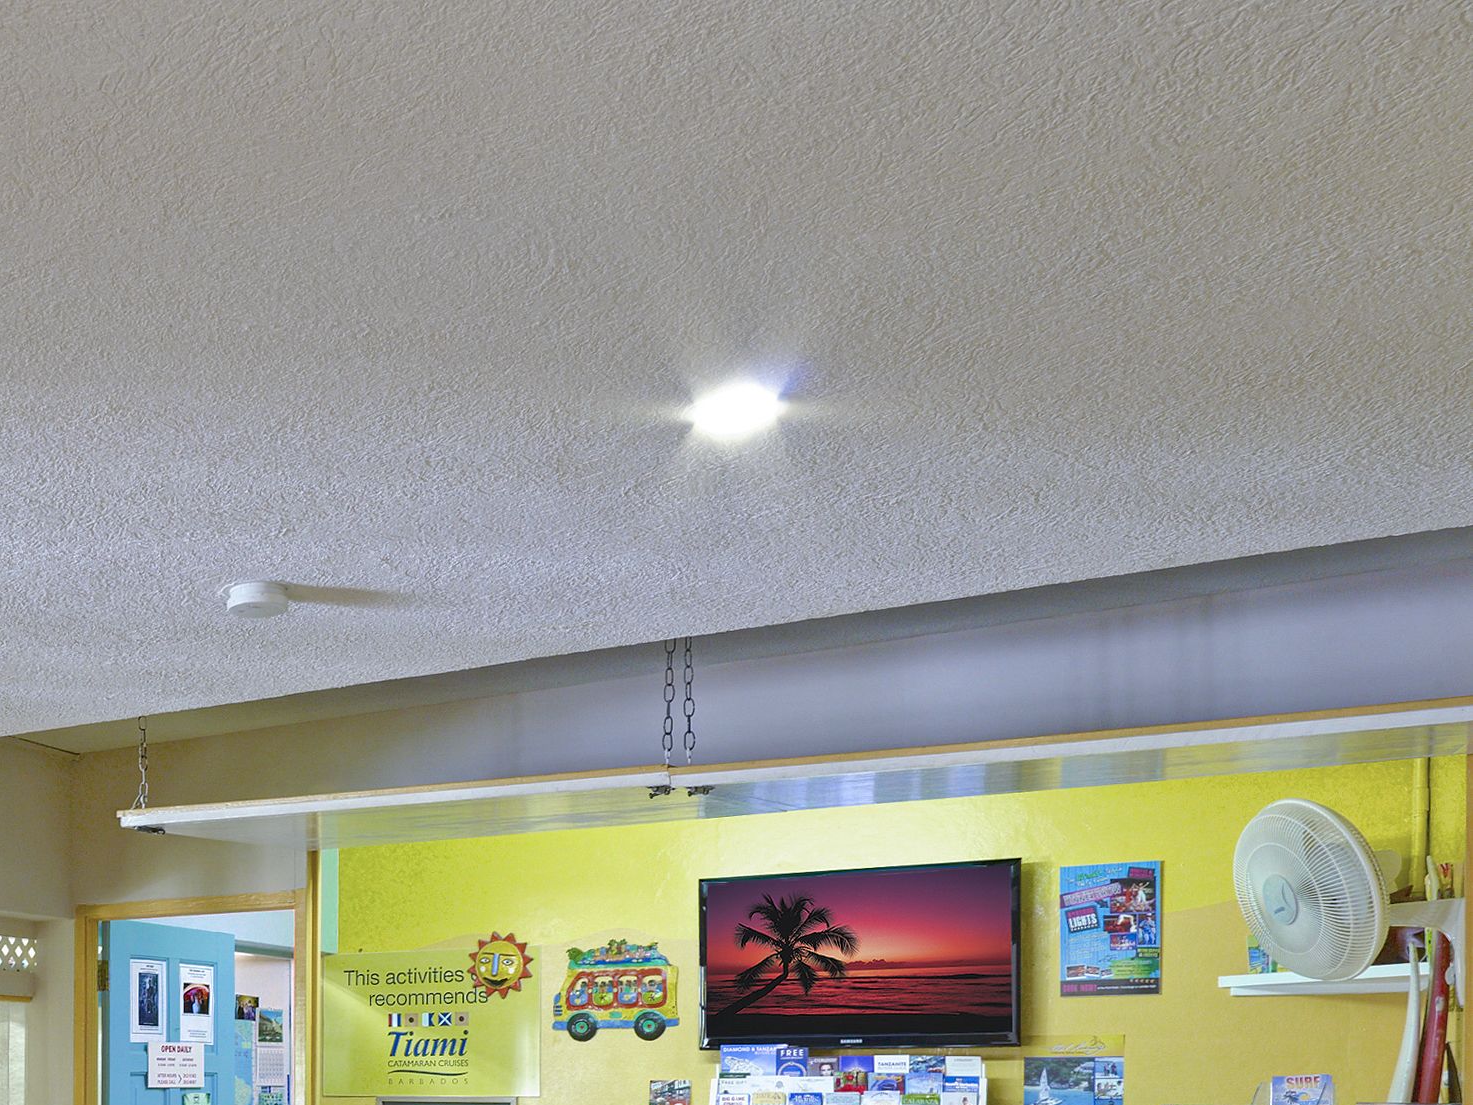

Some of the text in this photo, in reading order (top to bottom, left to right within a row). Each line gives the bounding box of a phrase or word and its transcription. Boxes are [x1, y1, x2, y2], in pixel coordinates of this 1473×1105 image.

[1069, 914, 1097, 929] LIGHTS
[344, 969, 379, 986] This
[385, 968, 464, 985] activities
[369, 989, 488, 1007] recommends
[161, 1045, 192, 1053] OPEN DAILY
[388, 1030, 469, 1057] Tiami
[438, 1059, 469, 1067] CRUISES
[1286, 1076, 1320, 1089] SURF
